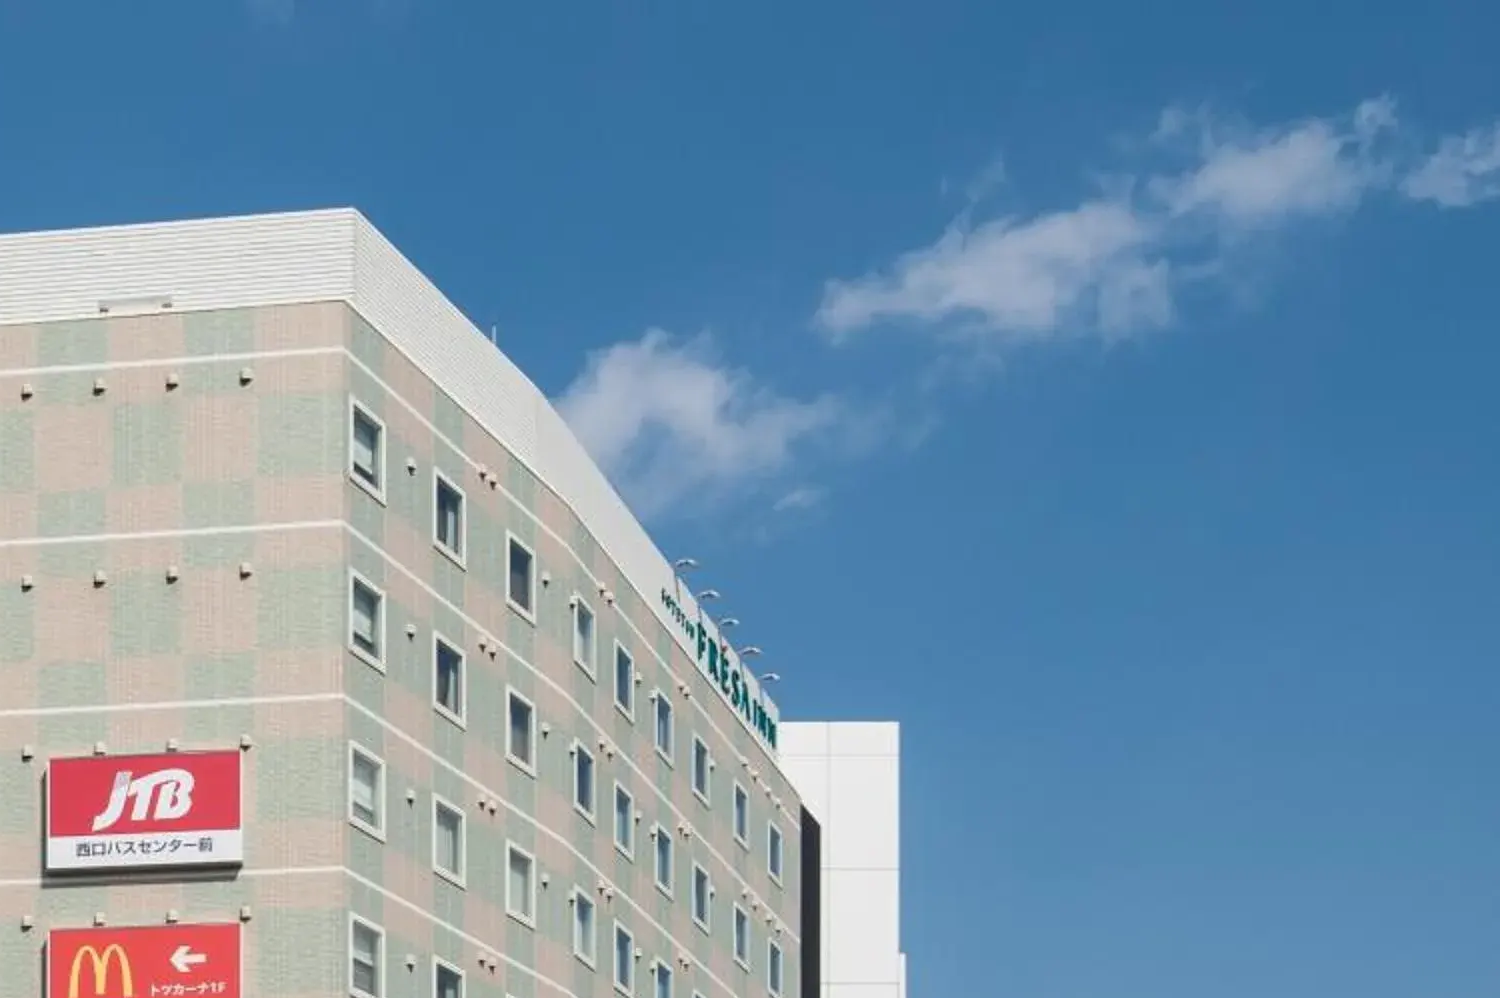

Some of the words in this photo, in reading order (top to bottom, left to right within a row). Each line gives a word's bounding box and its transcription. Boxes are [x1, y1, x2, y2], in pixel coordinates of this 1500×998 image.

[752, 698, 776, 750] INN
[91, 768, 195, 832] JTB
[75, 836, 214, 858] 西口バスセンター前
[150, 981, 228, 998] トツカーナ1F
